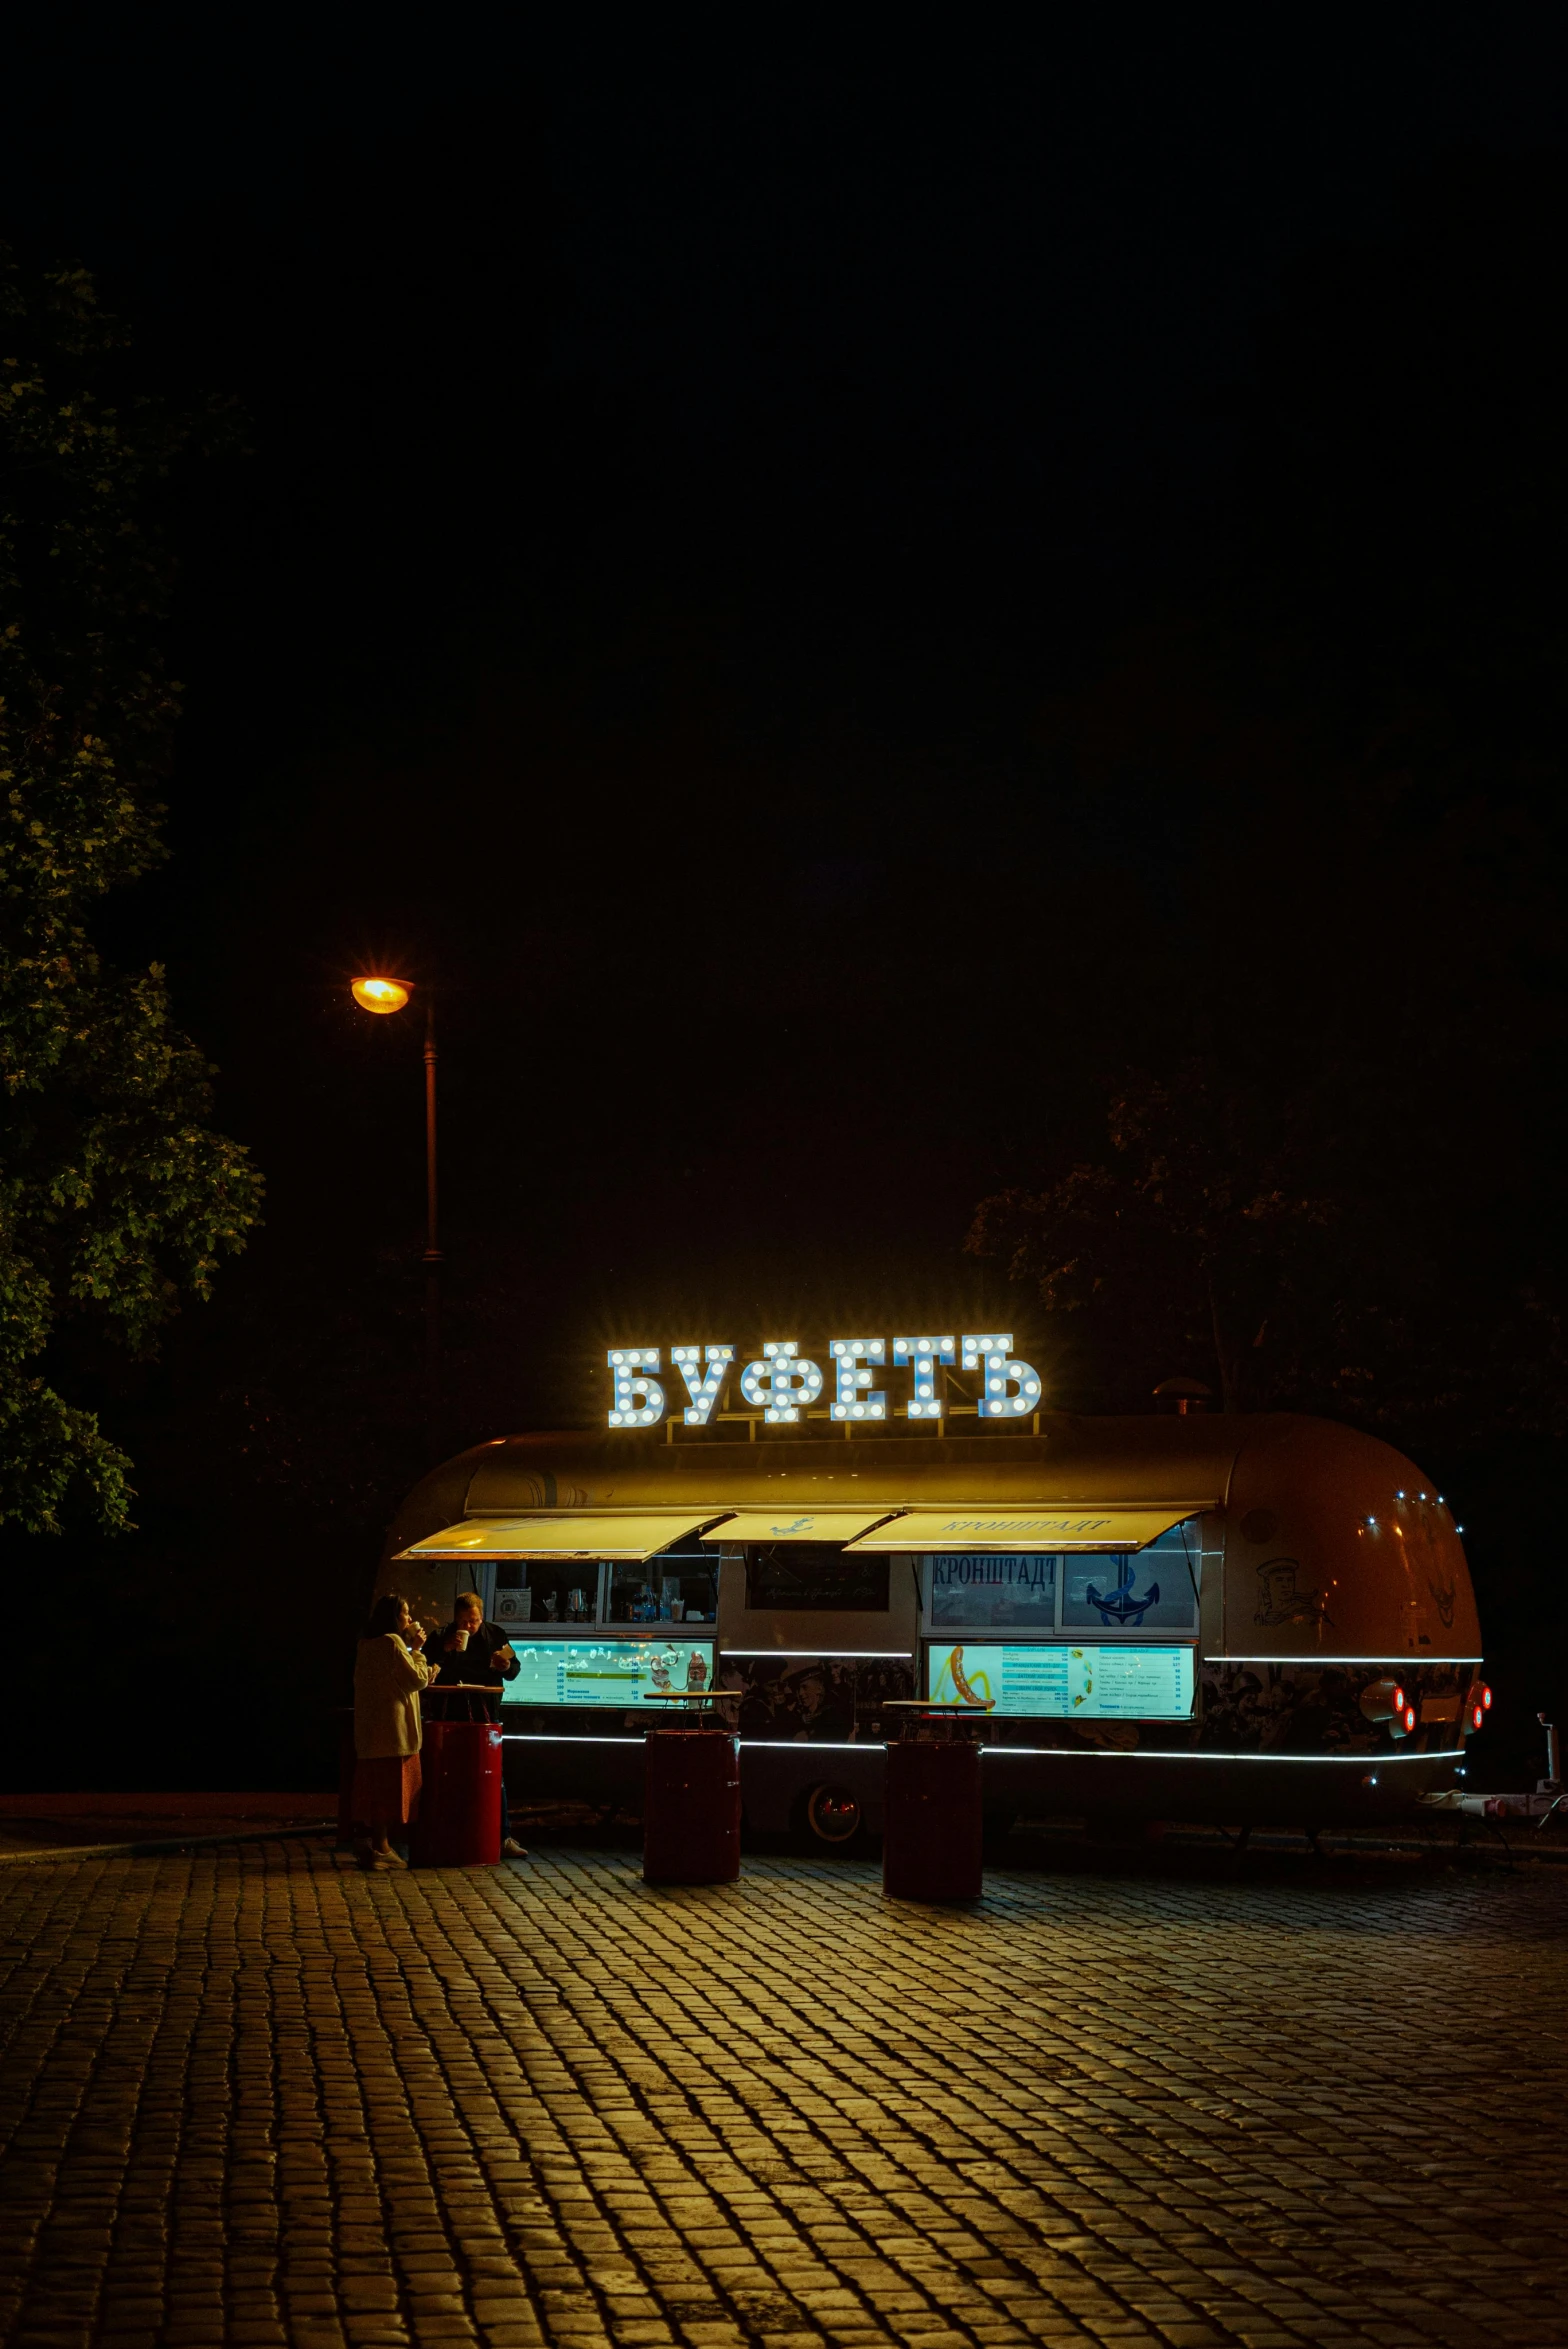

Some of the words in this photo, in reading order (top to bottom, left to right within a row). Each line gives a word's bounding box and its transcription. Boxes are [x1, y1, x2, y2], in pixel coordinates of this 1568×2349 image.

[608, 1334, 1042, 1429] БУФЕТЪ
[941, 1520, 1111, 1532] КРОНШТАДТ
[933, 1557, 1057, 1592] КРОНШТАДТ
